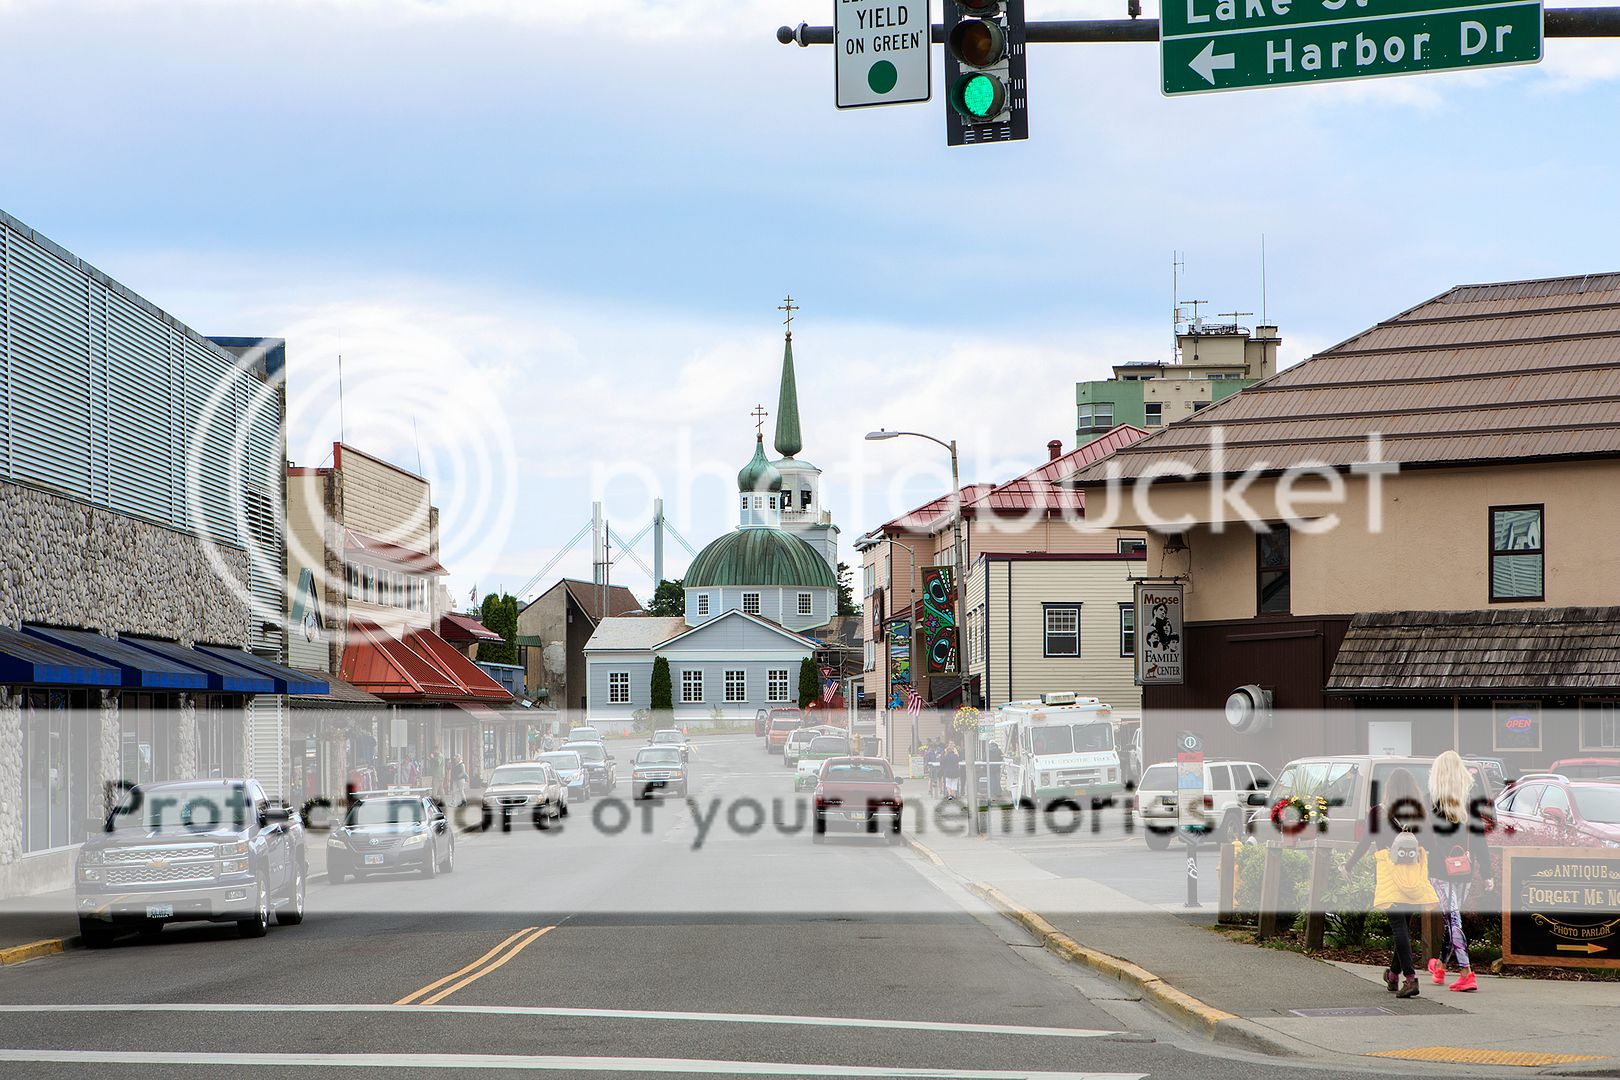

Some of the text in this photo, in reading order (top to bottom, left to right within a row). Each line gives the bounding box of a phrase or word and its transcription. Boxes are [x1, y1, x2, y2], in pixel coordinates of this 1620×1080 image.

[857, 6, 908, 30] YIELD
[846, 32, 919, 55] ON GREEN
[1266, 20, 1513, 74] Harbor Dr
[1144, 593, 1180, 605] Moose
[1145, 650, 1180, 663] FAMILY
[1157, 666, 1181, 676] CENTER
[1506, 719, 1532, 729] OPEN
[1554, 864, 1608, 880] ANTIQUE
[1529, 887, 1580, 905] FORGET
[1584, 888, 1604, 906] ME
[1553, 924, 1611, 937] PHOTO PARLOR
